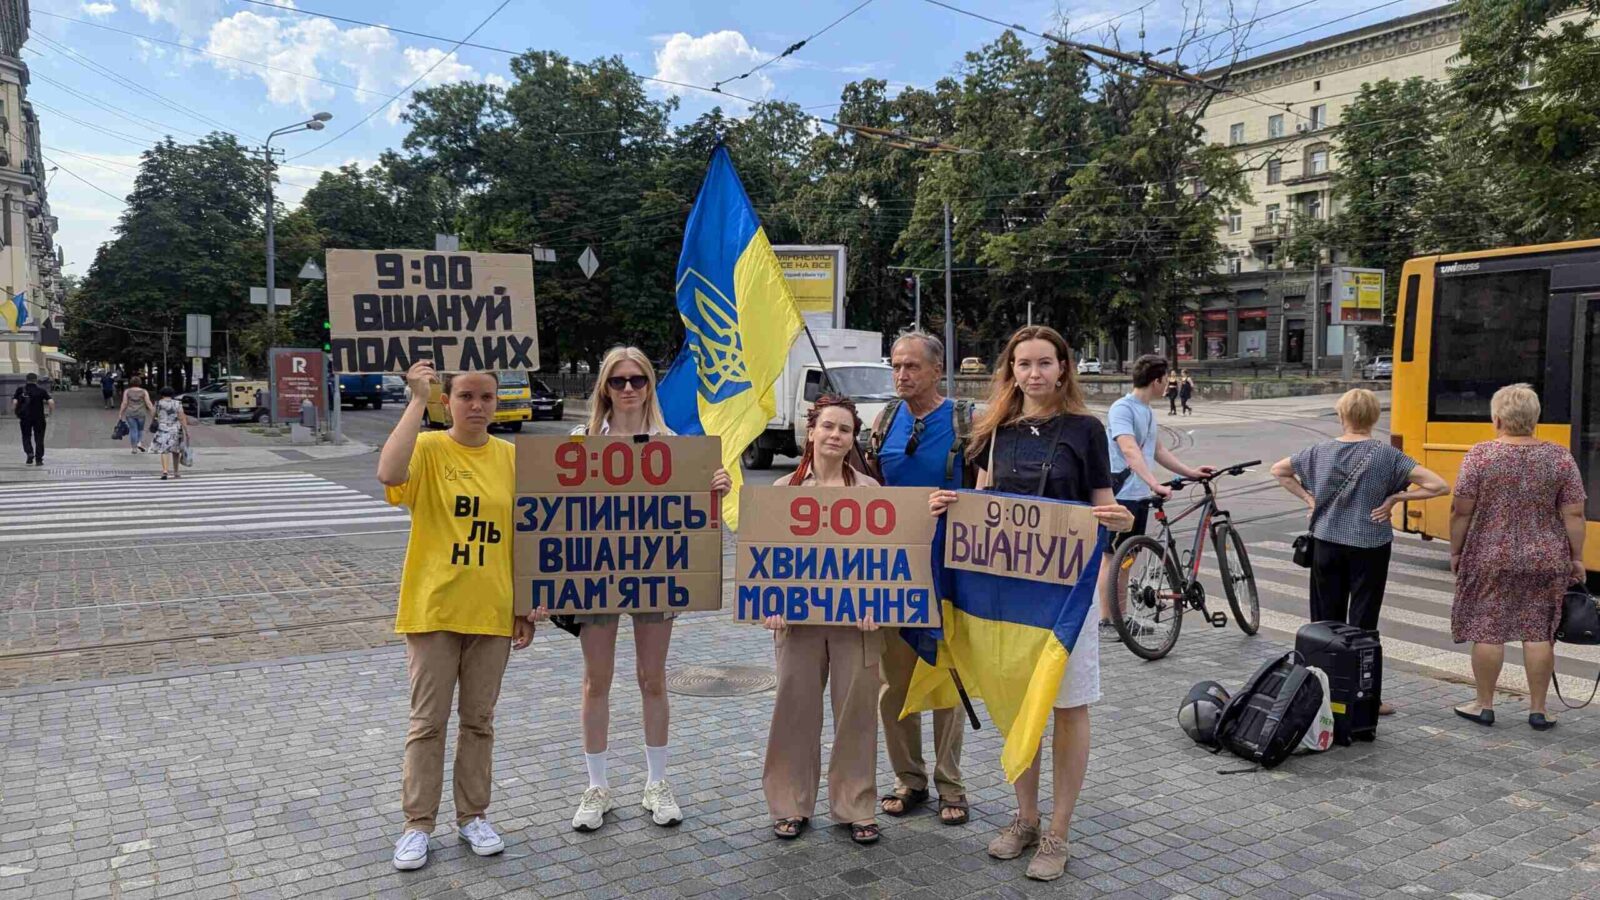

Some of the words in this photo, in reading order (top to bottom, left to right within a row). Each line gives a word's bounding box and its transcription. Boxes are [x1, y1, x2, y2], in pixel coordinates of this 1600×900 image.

[375, 254, 473, 290] 9:00
[353, 286, 512, 332] ВШАНУЙ
[292, 357, 307, 373] R
[331, 334, 533, 372] ПОЛЕГЛИХ
[555, 441, 672, 486] 9:00
[454, 495, 480, 517] ВІ
[516, 490, 718, 532] ЗУПИНИСЬ!
[789, 497, 896, 536] 9:00
[984, 501, 1041, 528] 9:00
[467, 520, 501, 544] ЛЬ
[952, 521, 1084, 580] ВШАНУЙ
[539, 530, 689, 573] ВШАНУЙ
[748, 546, 912, 581] ХВИЛИНА
[532, 574, 689, 610] ПАМ'ЯТЬ
[738, 585, 929, 624] МОВЧАННЯ
